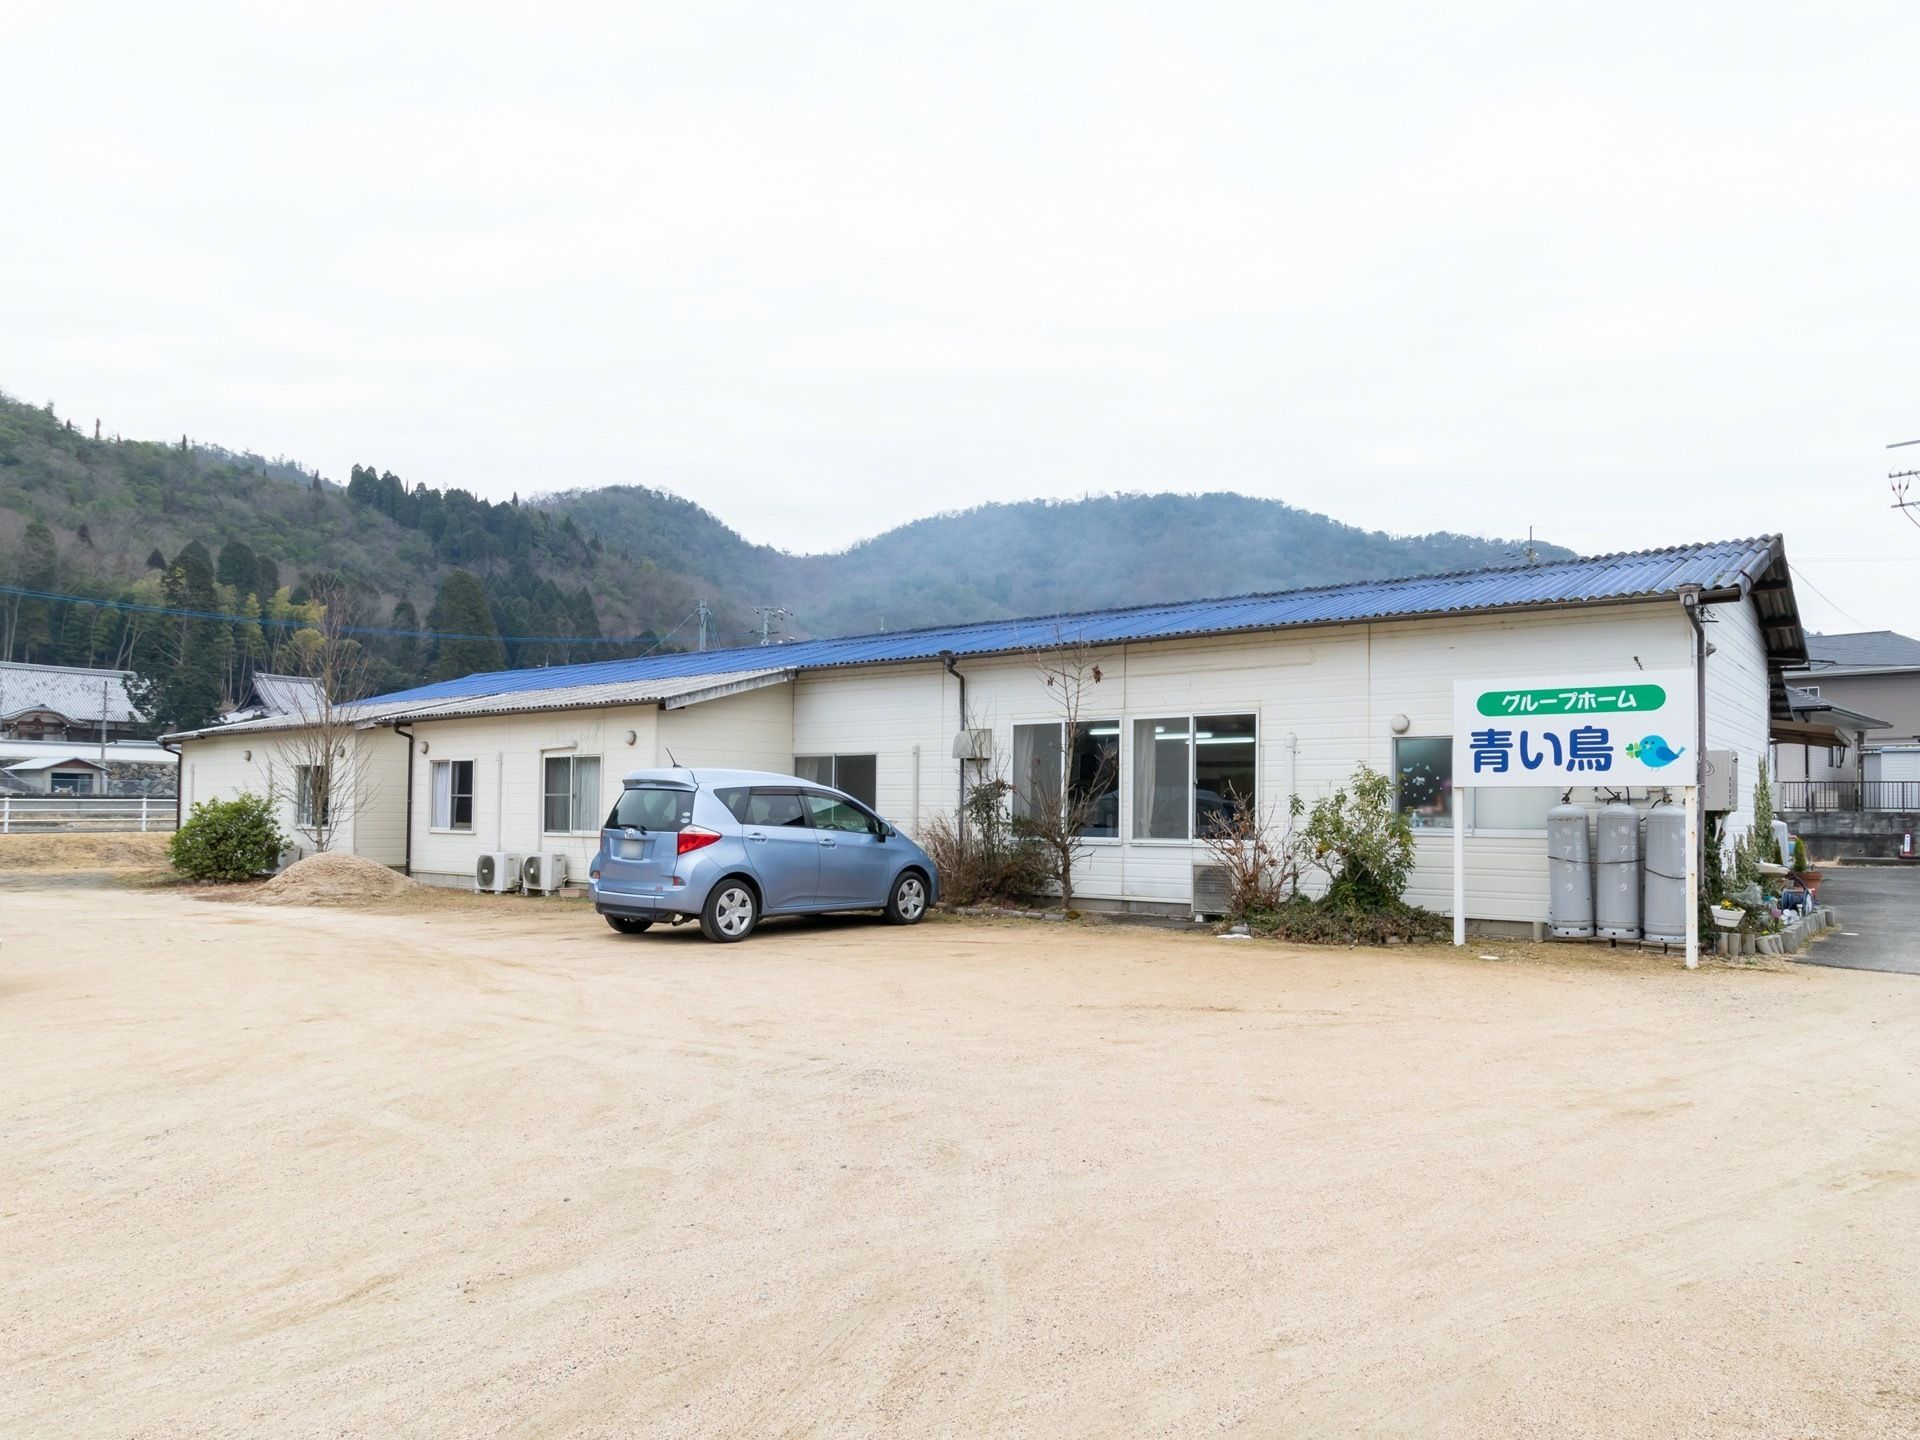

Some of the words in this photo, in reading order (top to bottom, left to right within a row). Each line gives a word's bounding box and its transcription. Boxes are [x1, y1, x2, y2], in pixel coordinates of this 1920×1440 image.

[1501, 690, 1637, 713] グループホーム
[1469, 725, 1614, 774] 青い鳥
